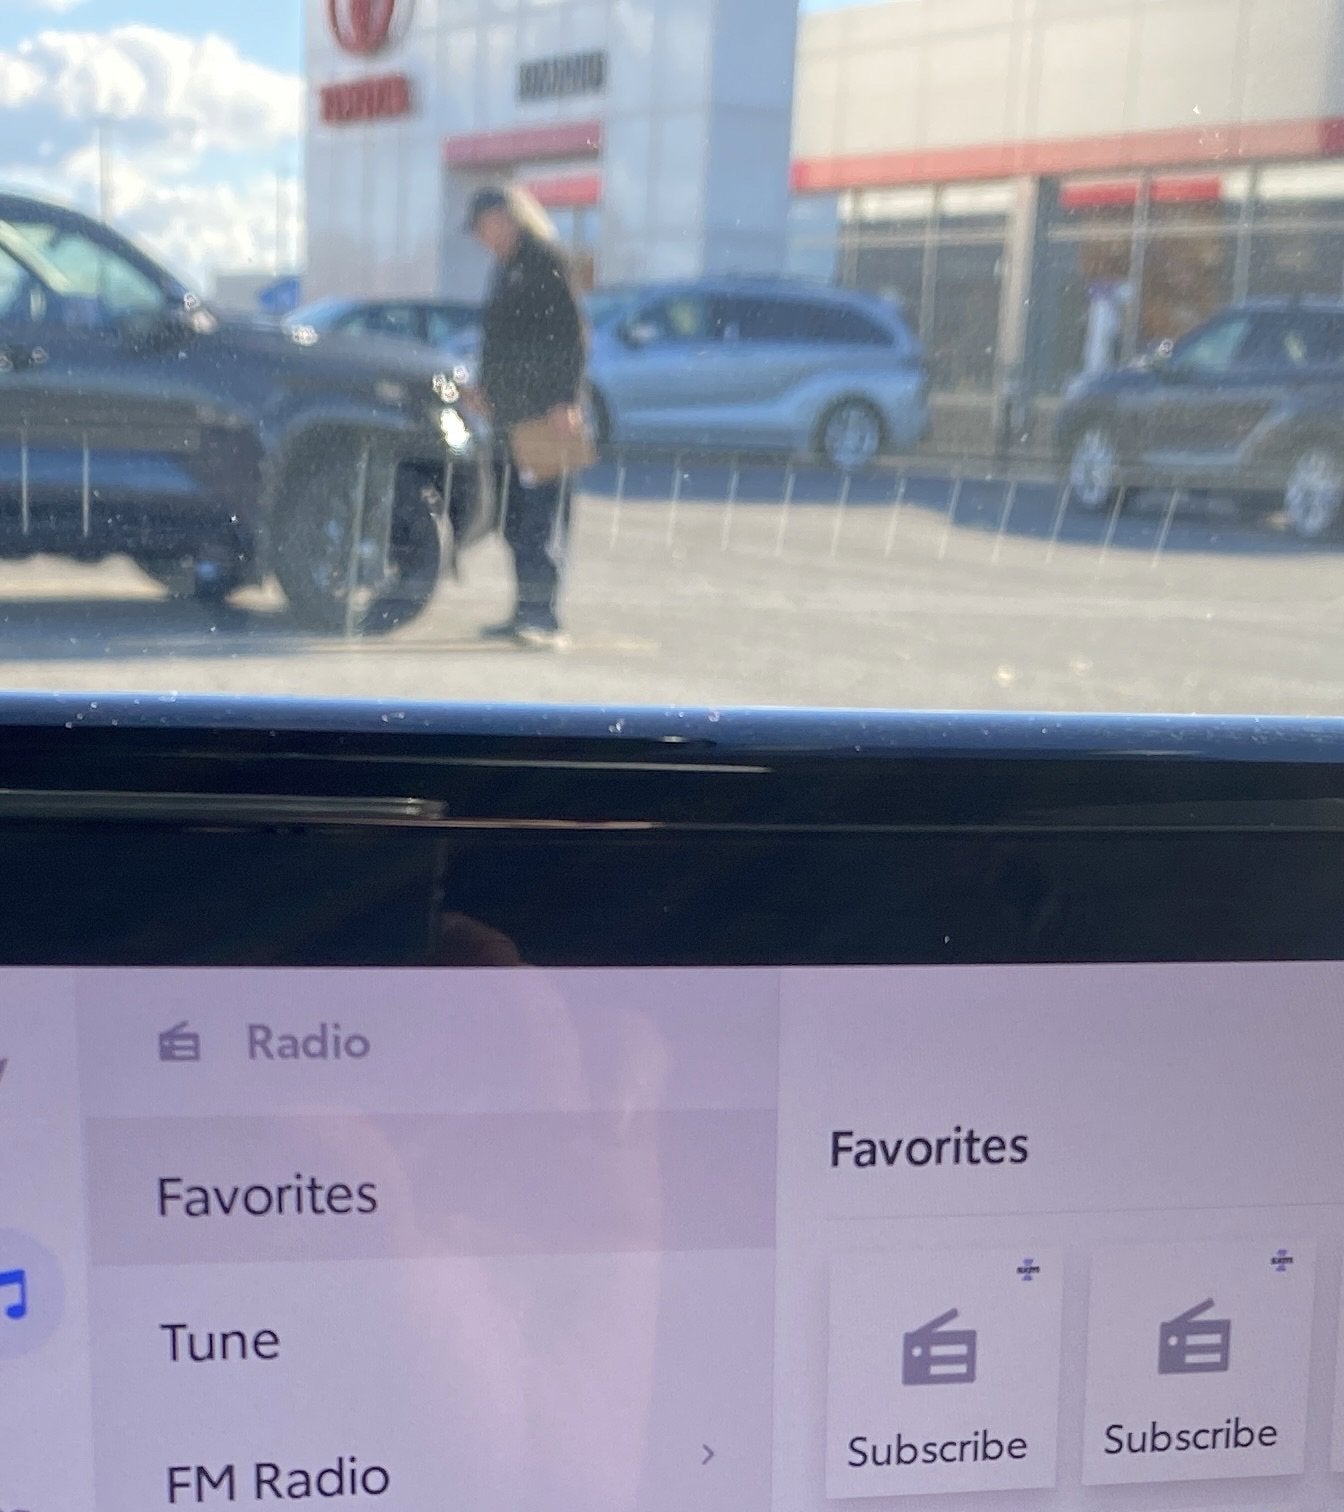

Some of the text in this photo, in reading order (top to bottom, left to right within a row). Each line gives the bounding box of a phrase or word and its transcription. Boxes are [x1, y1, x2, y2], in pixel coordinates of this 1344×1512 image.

[246, 1022, 371, 1061] Radio
[830, 1125, 1029, 1169] Favorites
[157, 1172, 378, 1217] Favorites
[160, 1322, 281, 1363] Tune
[848, 1429, 1028, 1468] Subscribe
[1104, 1416, 1279, 1456] Subscribe
[167, 1454, 391, 1504] FM Radio
